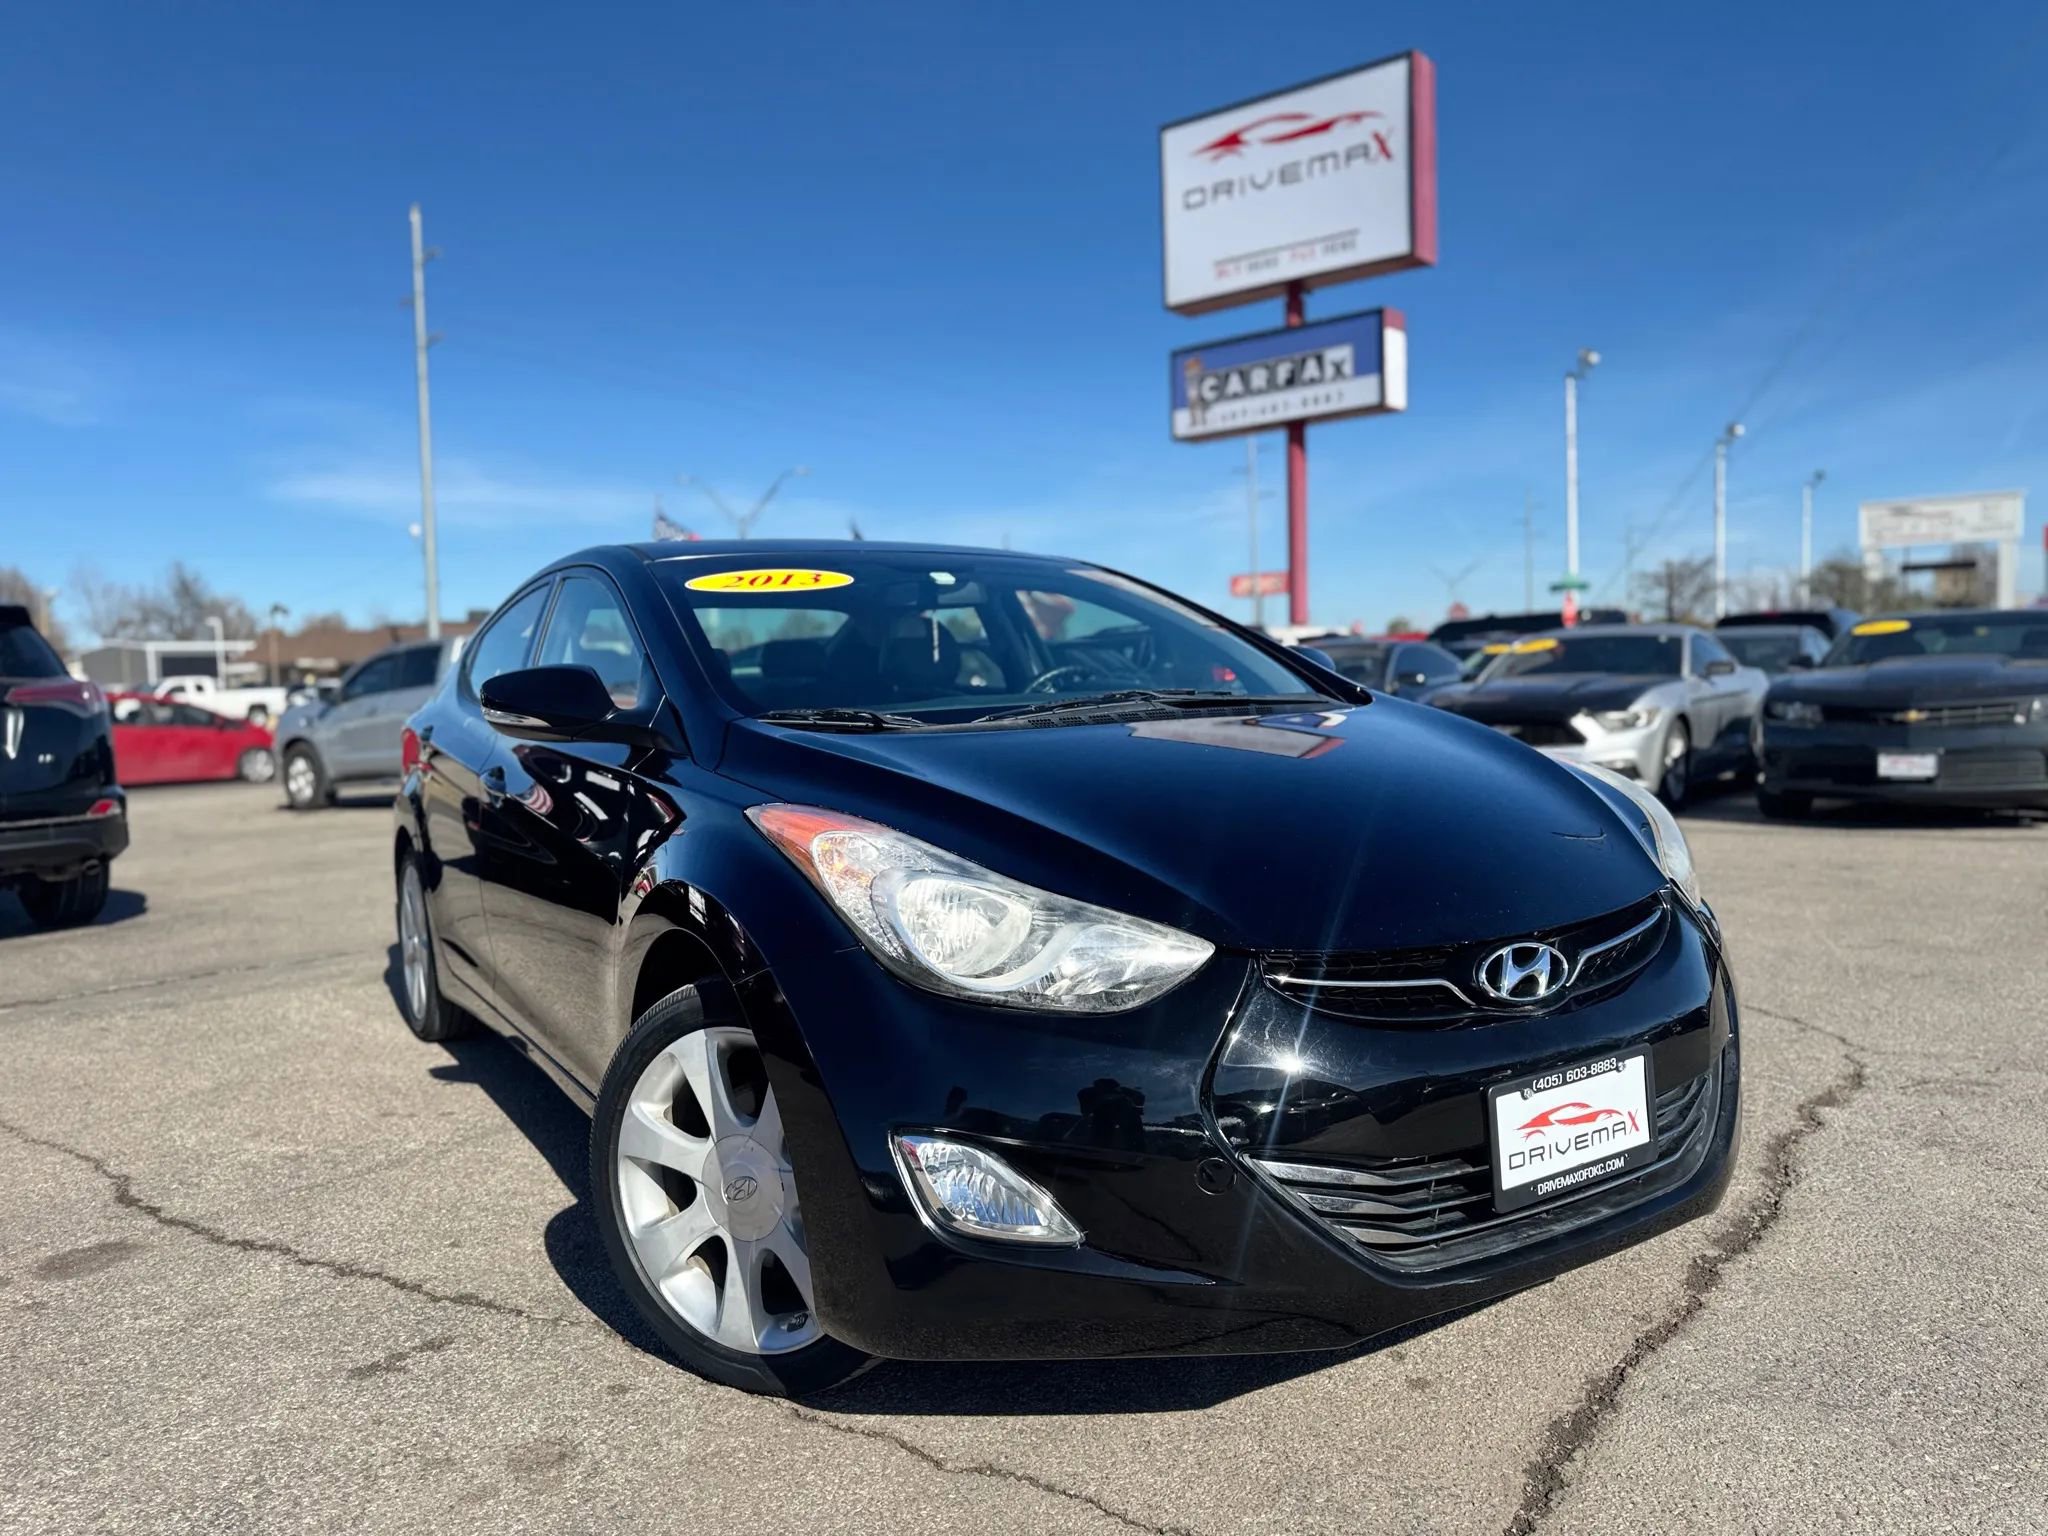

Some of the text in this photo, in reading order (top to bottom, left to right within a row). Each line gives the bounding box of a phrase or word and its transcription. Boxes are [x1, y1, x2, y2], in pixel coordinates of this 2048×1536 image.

[1181, 126, 1395, 211] DRIVEMAX
[1200, 351, 1351, 402] CARFAX
[721, 572, 823, 589] 2013
[1532, 1057, 1617, 1092] (405) 603-8883
[1508, 1108, 1640, 1171] DRIVEMAX
